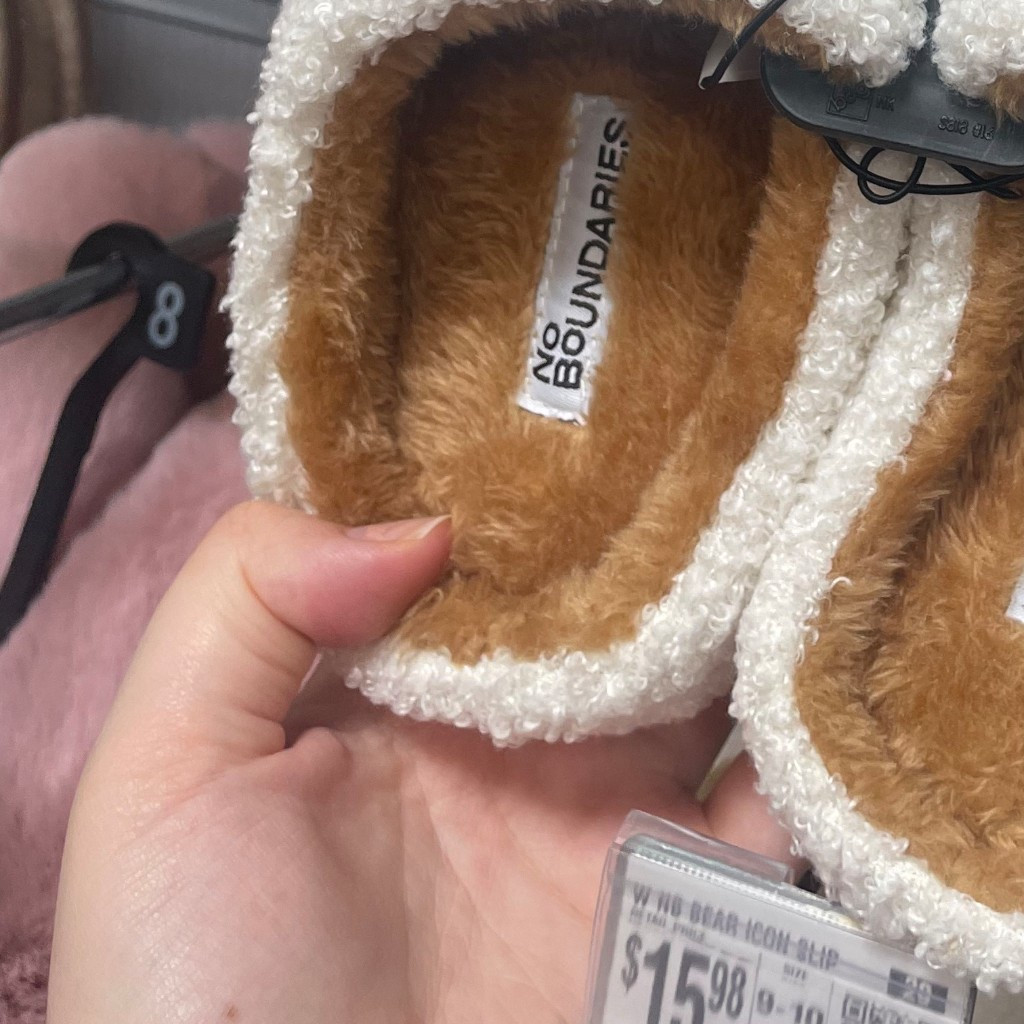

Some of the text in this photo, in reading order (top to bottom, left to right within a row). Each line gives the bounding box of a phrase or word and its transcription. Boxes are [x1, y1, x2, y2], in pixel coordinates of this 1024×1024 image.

[553, 117, 628, 389] BOUNDARIES
[147, 280, 186, 349] 8
[532, 322, 560, 384] NO
[744, 918, 791, 956] ICON
[796, 936, 840, 971] SLIP
